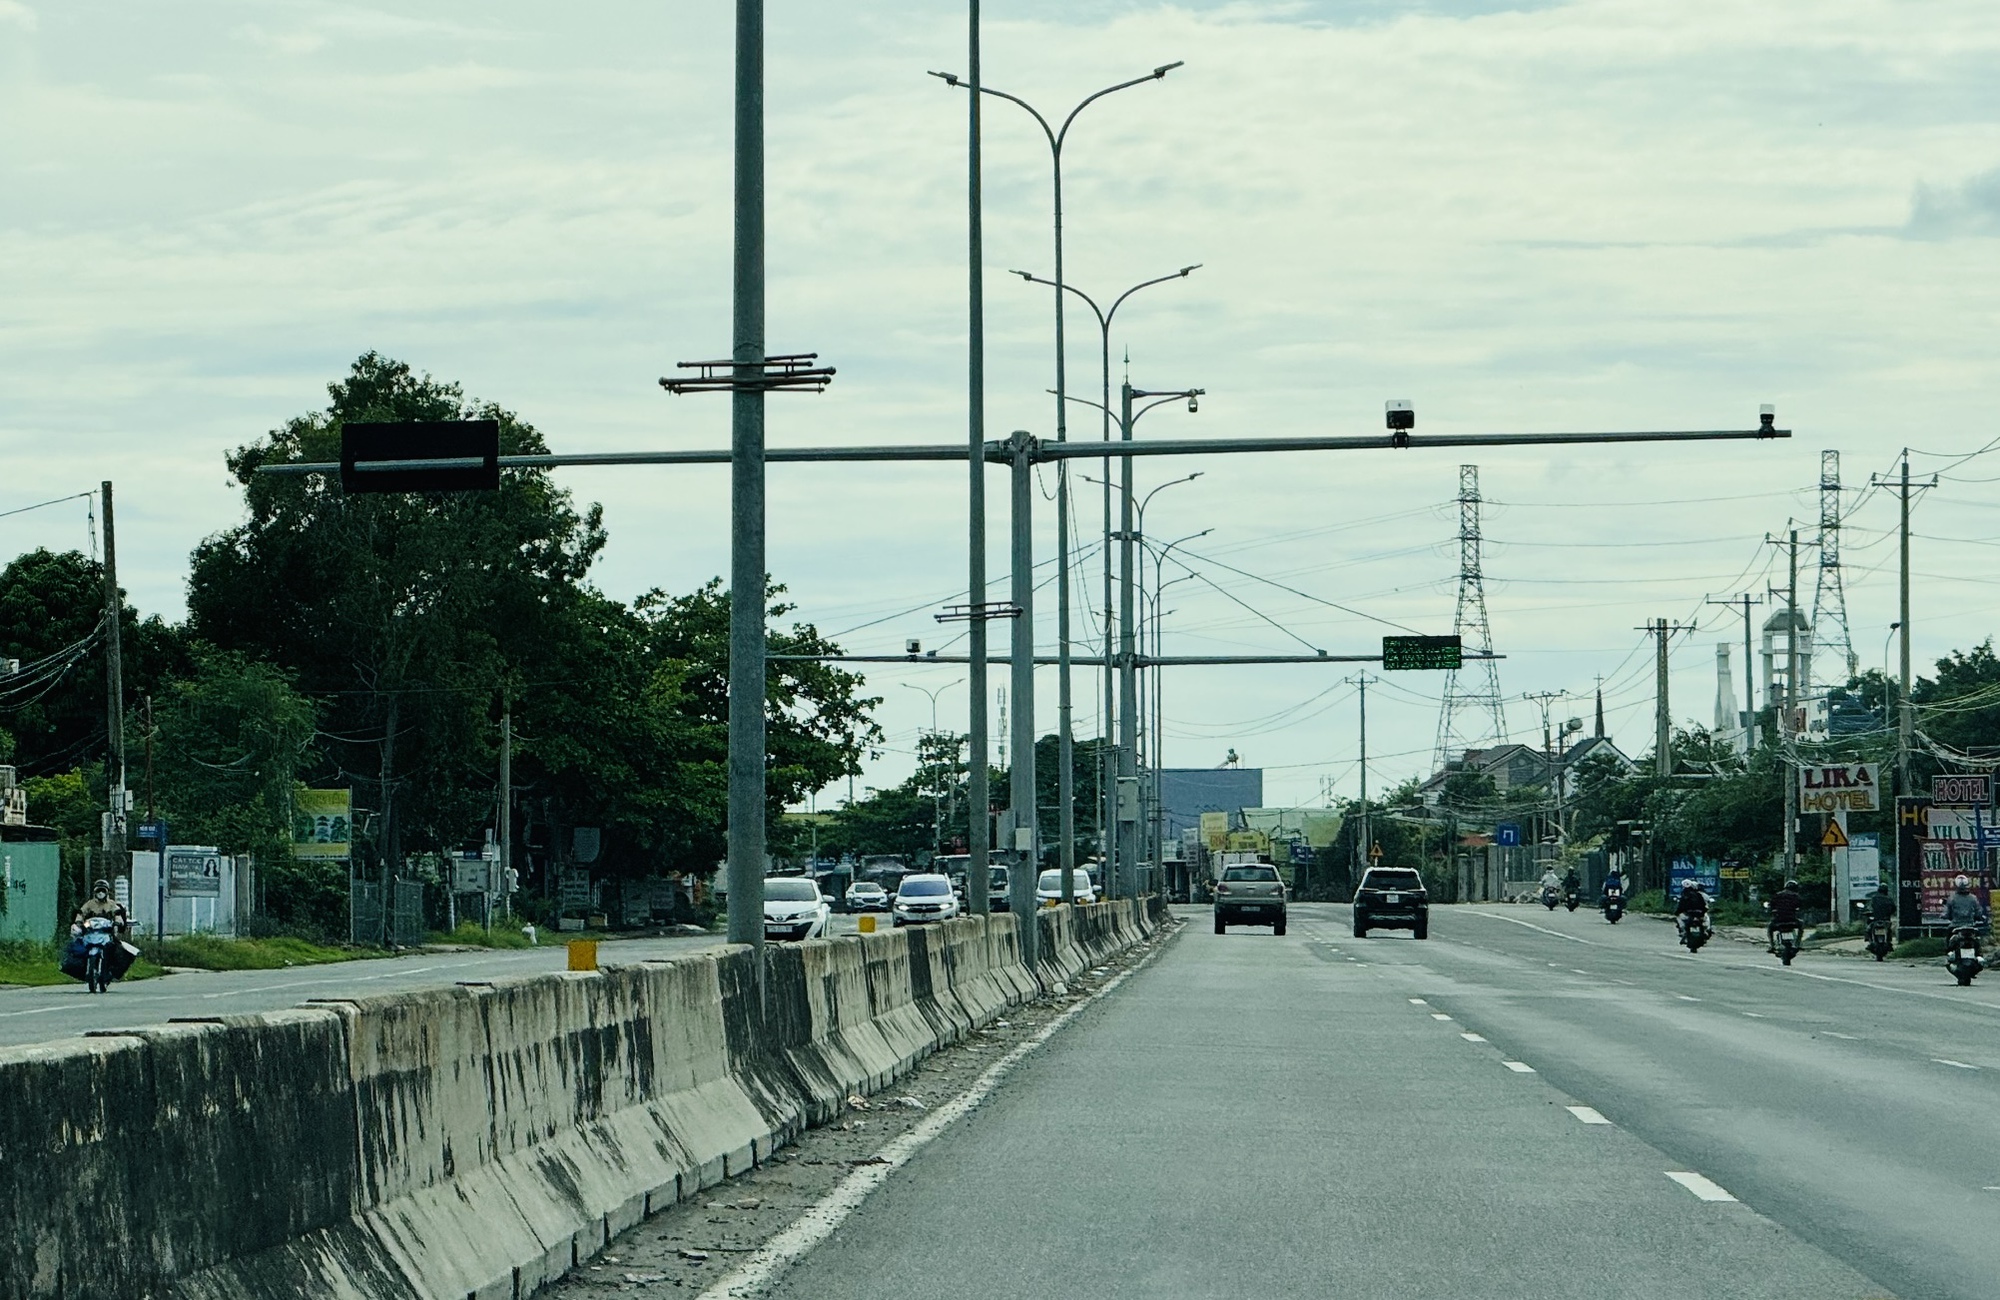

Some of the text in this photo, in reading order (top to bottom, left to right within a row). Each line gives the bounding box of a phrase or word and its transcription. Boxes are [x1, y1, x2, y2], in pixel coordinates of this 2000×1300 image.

[1804, 767, 1873, 788] LIKA
[1804, 790, 1875, 811] HOTEL
[1935, 779, 1988, 801] HOTEL
